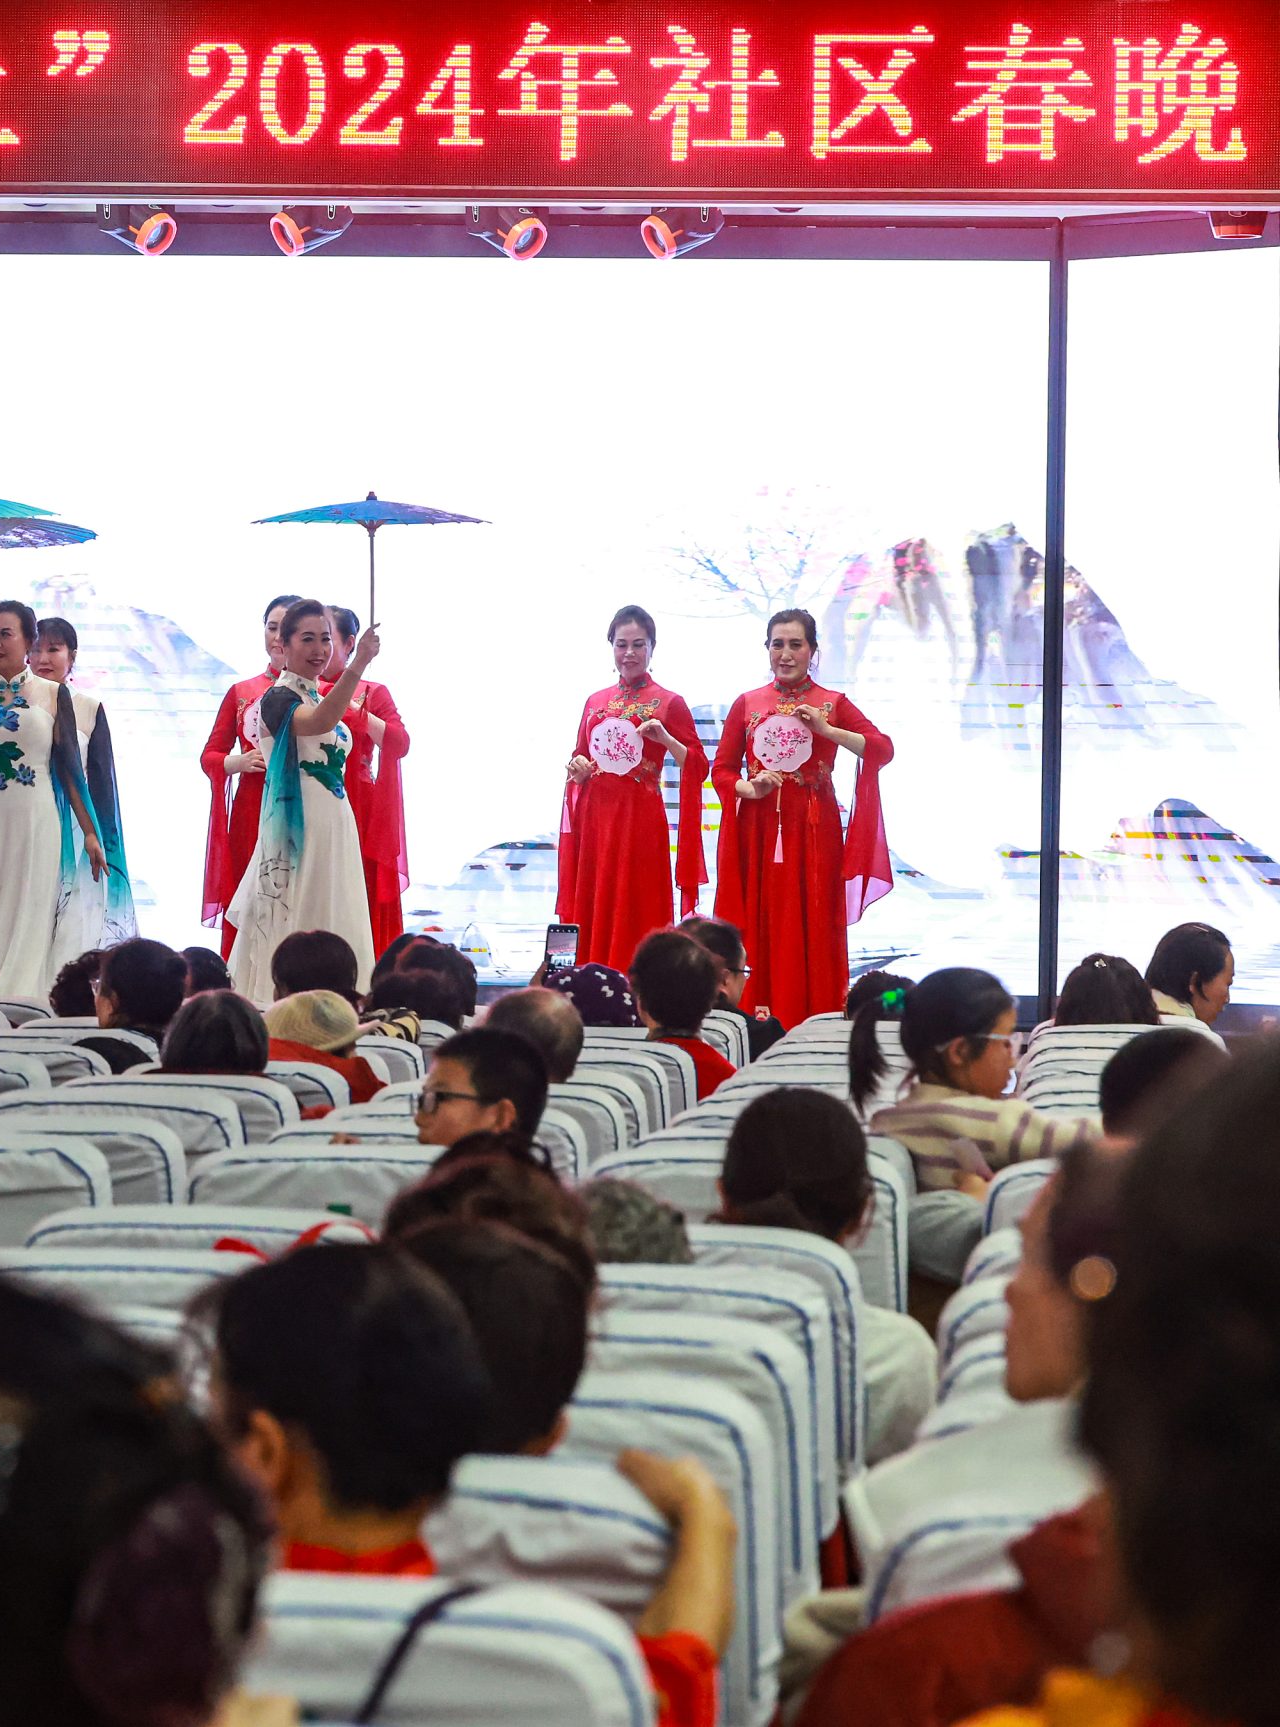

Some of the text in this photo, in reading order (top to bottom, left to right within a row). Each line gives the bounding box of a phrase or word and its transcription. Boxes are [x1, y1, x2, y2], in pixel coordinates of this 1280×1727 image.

[183, 22, 1249, 163] 2024年社区春晚
